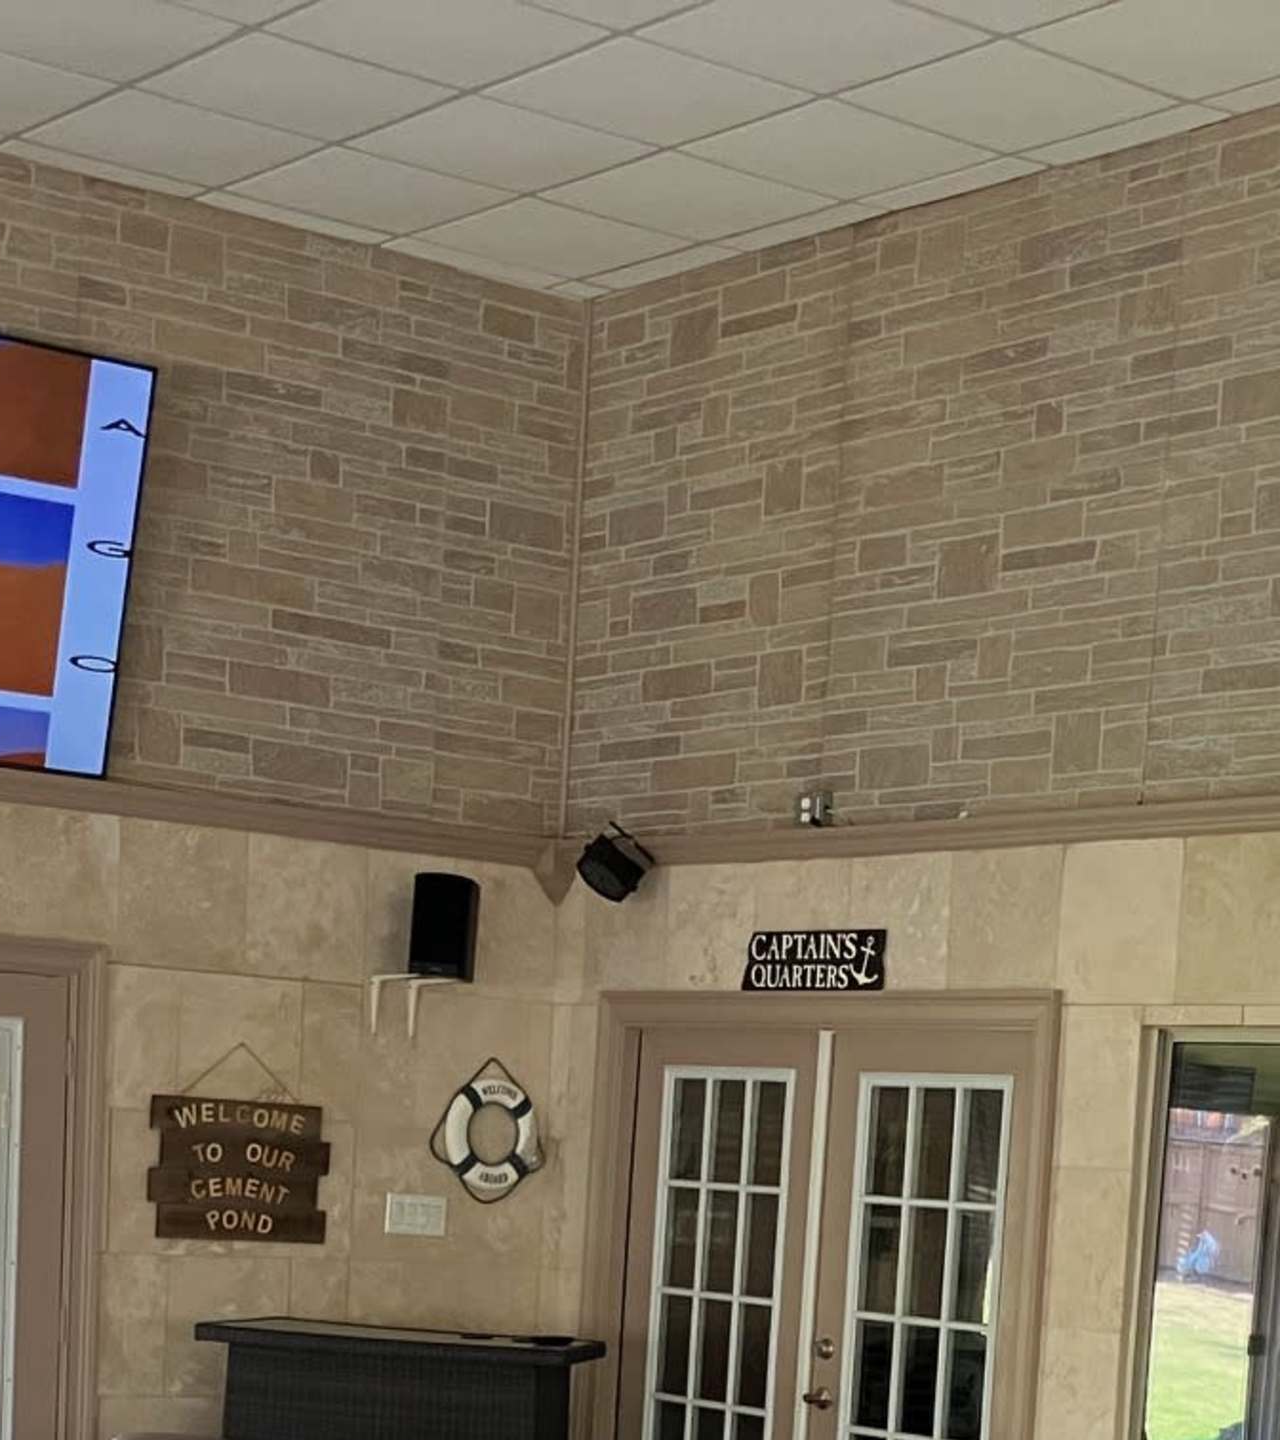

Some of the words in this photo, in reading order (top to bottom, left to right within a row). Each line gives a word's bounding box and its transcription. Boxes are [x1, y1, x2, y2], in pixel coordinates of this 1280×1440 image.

[751, 932, 859, 961] CAPTAIN'S
[751, 963, 850, 989] QUARTERS
[174, 1102, 306, 1136] WELCOME
[192, 1143, 223, 1164] TO
[246, 1142, 296, 1172] OUR
[190, 1176, 291, 1205] CEMENT
[205, 1209, 274, 1235] POND
